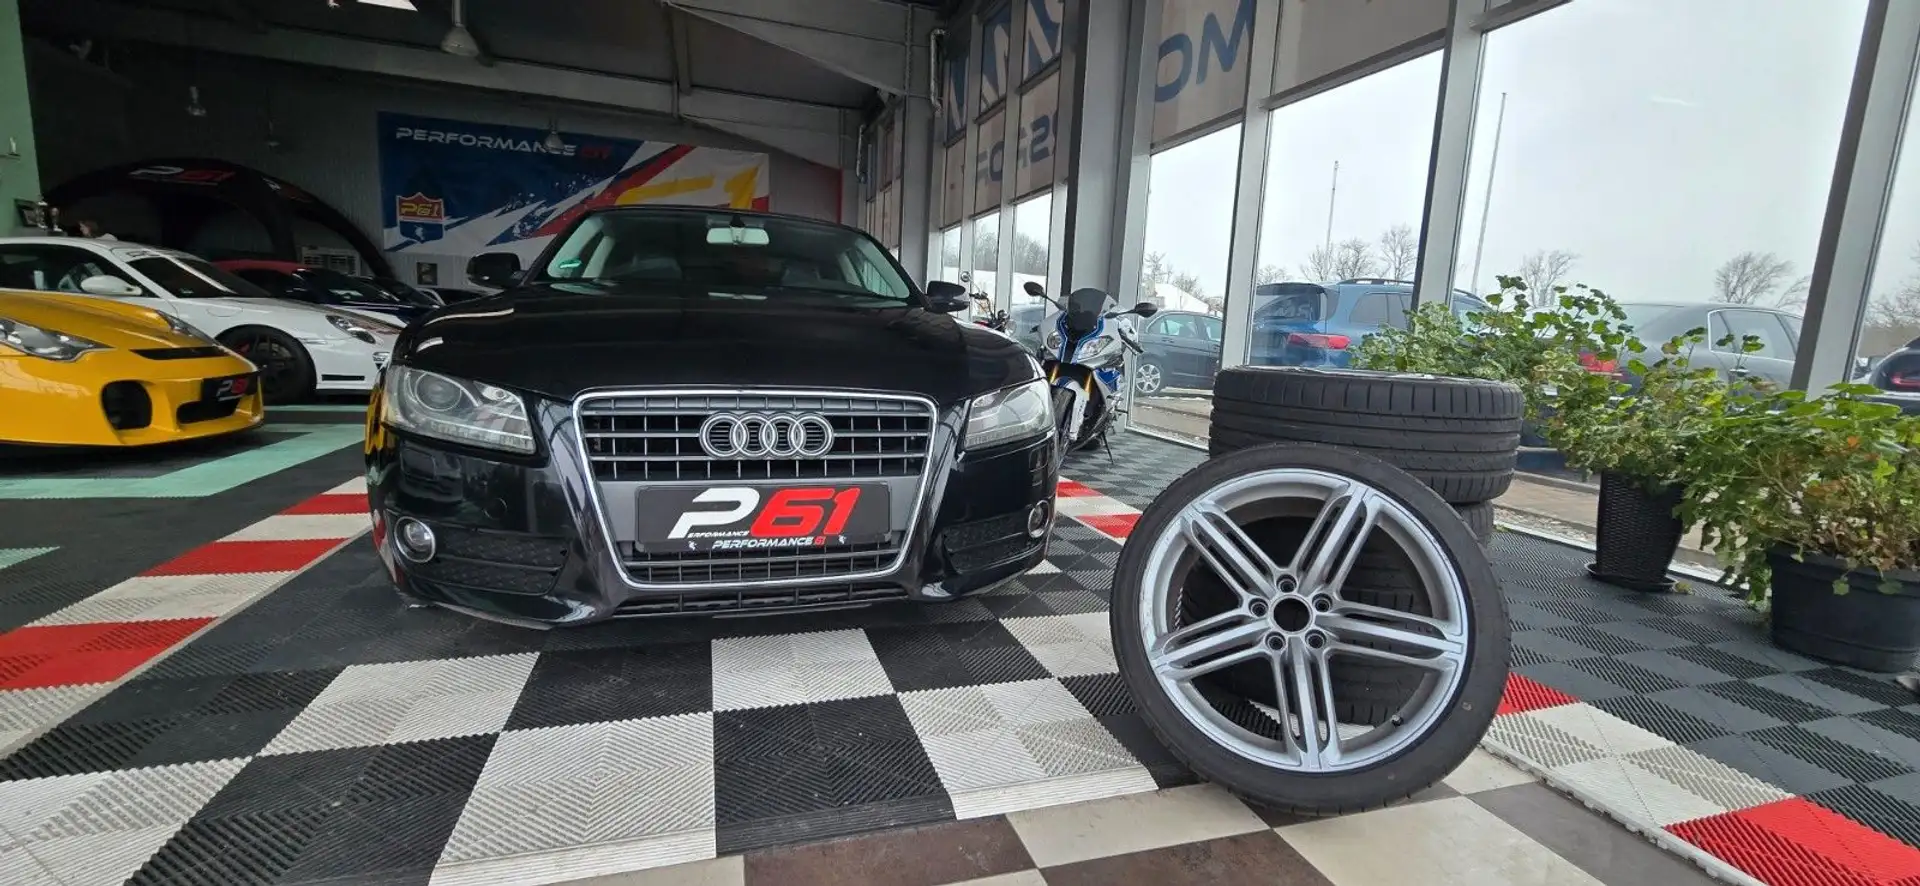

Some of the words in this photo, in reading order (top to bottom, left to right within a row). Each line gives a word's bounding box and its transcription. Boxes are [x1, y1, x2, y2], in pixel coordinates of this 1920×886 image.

[395, 126, 577, 157] PERFORMANCE
[400, 201, 441, 217] P61
[667, 487, 861, 540] P61
[711, 536, 813, 550] PERFORMANCE
[814, 536, 827, 548] 61
